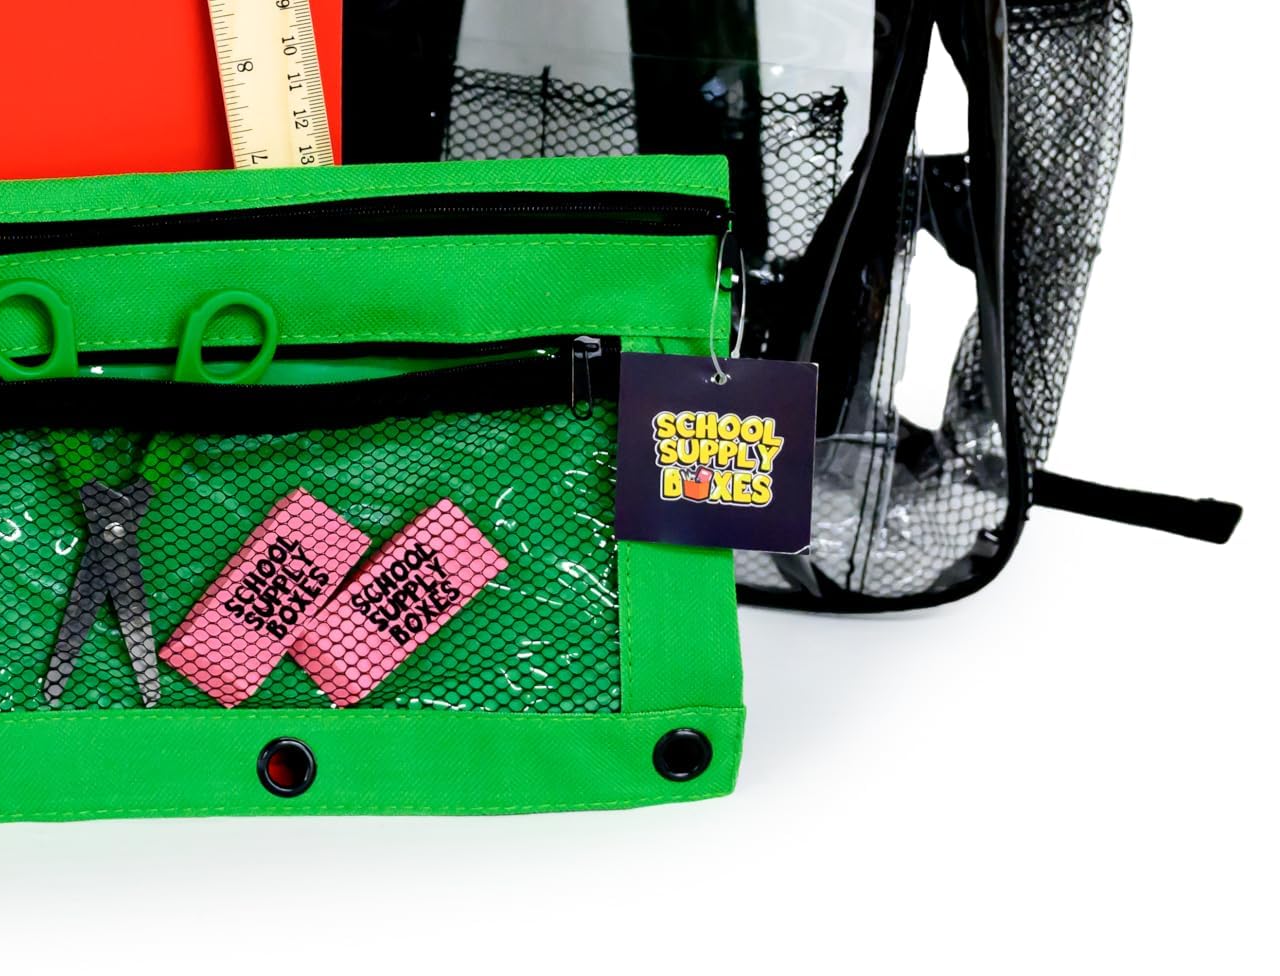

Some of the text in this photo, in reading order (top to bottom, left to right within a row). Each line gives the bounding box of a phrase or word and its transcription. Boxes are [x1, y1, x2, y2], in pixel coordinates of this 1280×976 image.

[282, 35, 297, 56] 10
[237, 60, 254, 72] 8
[288, 73, 303, 92] 11
[293, 109, 309, 129] 12
[299, 145, 315, 165] 13
[652, 411, 784, 446] SCHOOL
[656, 438, 782, 473] SUPPLY
[225, 536, 300, 618] SCHOOL
[244, 546, 313, 631] SUPPLY
[351, 543, 437, 616] SCHOOL
[368, 556, 447, 632] SUPPLY
[266, 567, 329, 640] BOXES
[389, 580, 460, 645] BOXES
